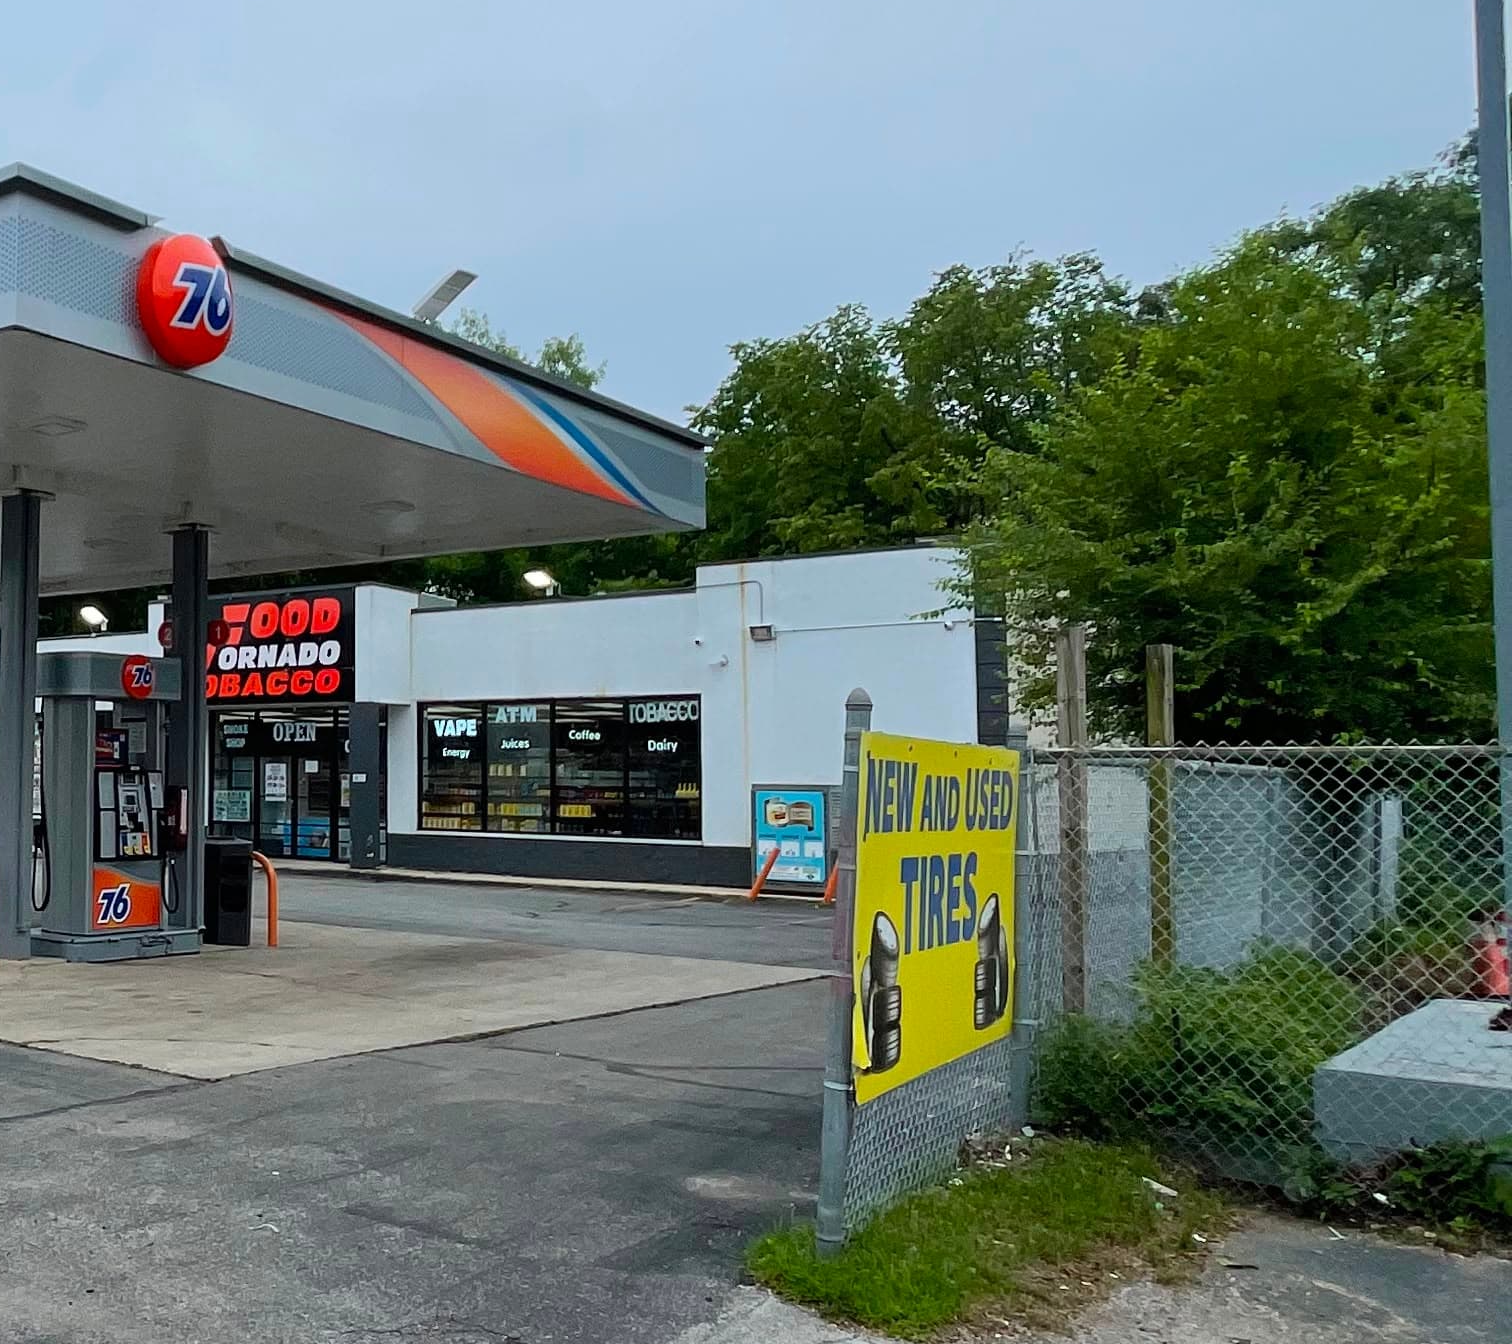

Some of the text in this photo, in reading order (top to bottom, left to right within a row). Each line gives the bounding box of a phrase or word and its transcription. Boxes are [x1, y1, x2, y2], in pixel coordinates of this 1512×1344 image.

[169, 262, 232, 336] 76
[217, 640, 341, 671] ORNADO
[131, 662, 153, 688] 76
[206, 668, 341, 698] OBACCO
[495, 705, 537, 723] ATM
[628, 700, 699, 724] TOBACCO
[273, 722, 317, 742] OPEN
[434, 719, 478, 737] VAPE
[568, 729, 601, 741] Coffee
[442, 747, 470, 759] Energy
[500, 738, 530, 749] Juices
[647, 738, 678, 753] Dairy
[865, 757, 918, 834] NEW
[919, 774, 960, 833] AND
[965, 767, 1014, 832] USED
[95, 882, 131, 924] 76
[900, 851, 979, 955] TIRES
